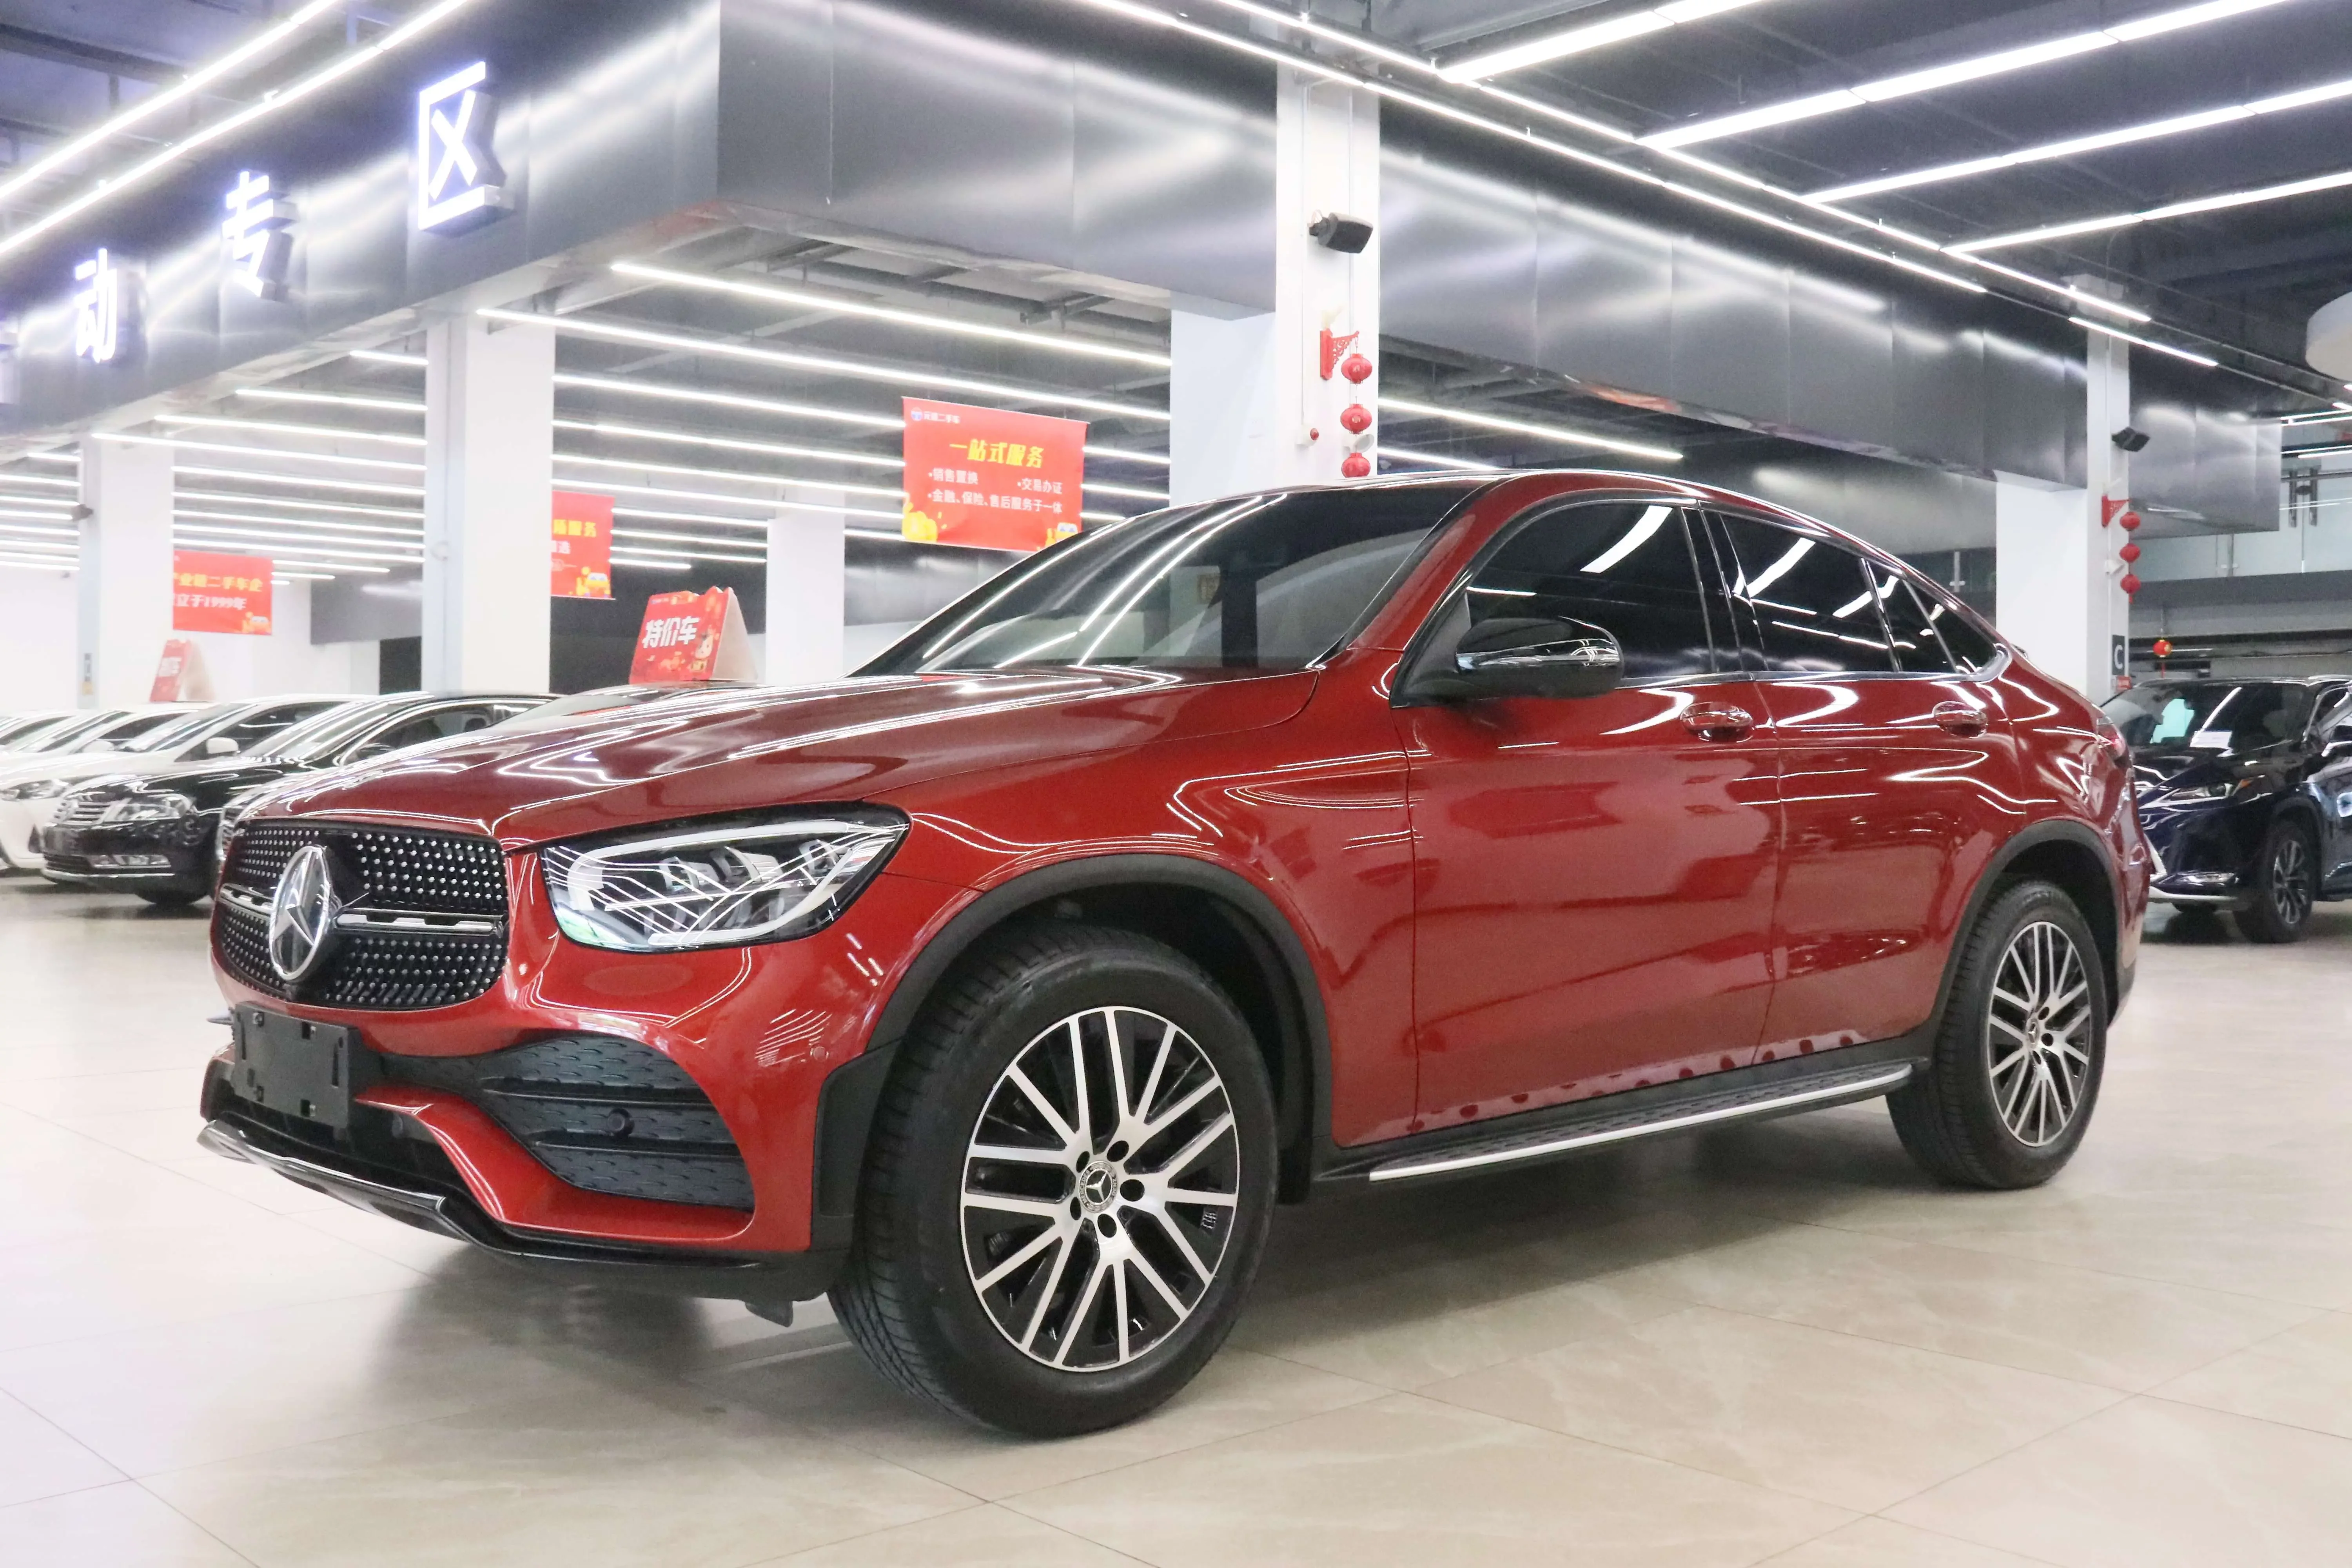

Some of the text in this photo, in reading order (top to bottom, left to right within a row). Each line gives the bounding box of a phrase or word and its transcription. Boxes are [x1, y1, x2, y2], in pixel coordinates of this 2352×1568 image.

[949, 439, 1044, 468] 一站式服务
[933, 468, 1062, 494] 销售置换 交易办证
[933, 489, 1062, 514] 金融、保险、售后服务于一体
[173, 593, 247, 610] 立于1999年
[642, 616, 700, 648] 特价车
[2114, 645, 2123, 669] C
[1080, 1169, 1091, 1204] MERCEDES
